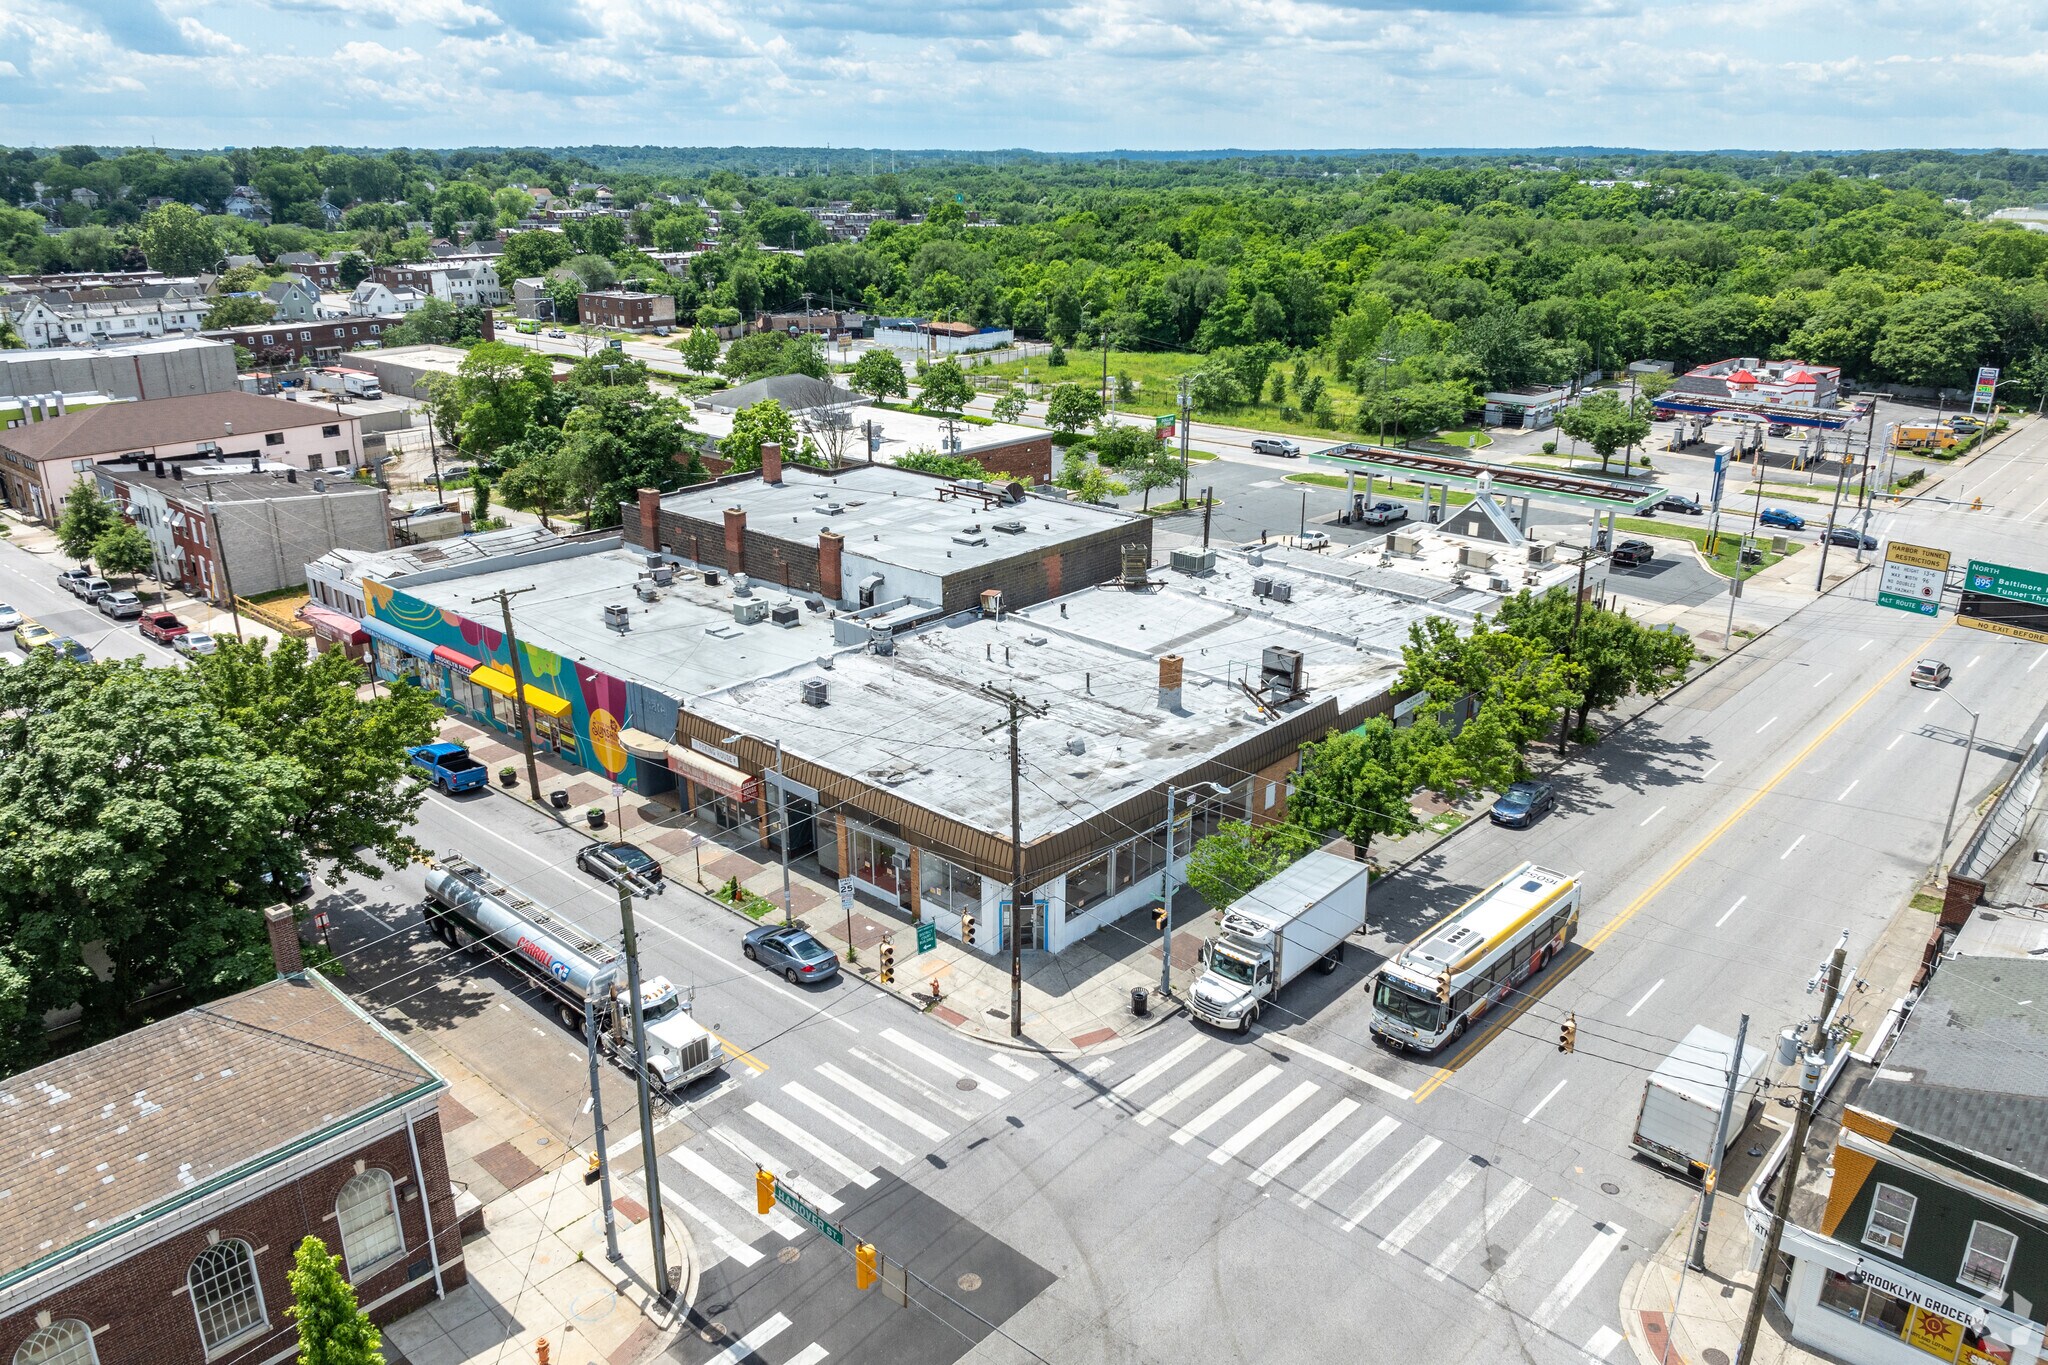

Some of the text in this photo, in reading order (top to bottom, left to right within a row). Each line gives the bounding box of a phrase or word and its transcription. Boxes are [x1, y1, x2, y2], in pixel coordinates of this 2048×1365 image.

[1892, 545, 1946, 560] HARBOR TUNNEL
[1895, 554, 1940, 567] RESTRICTIONS
[1904, 566, 1919, 574] HEIGHT
[1971, 564, 2000, 575] NORTH
[1896, 580, 1916, 588] DOUBLES
[1975, 578, 1991, 588] 895
[1998, 578, 2042, 592] Baltimore
[1997, 587, 2027, 598] Tunnel
[1895, 600, 1917, 608] ROUTE
[1921, 605, 1934, 613] 695
[1992, 625, 2010, 633] EXIT
[2013, 630, 2045, 641] BEFORE
[434, 653, 458, 670] BROOKLYN
[840, 885, 853, 893] 25
[516, 936, 553, 968] CARROLL
[777, 1188, 840, 1242] HANOVER ST.
[1860, 1271, 1982, 1330] BROOKLYN GROCERY
[1931, 1341, 1953, 1354] LOTTERY
